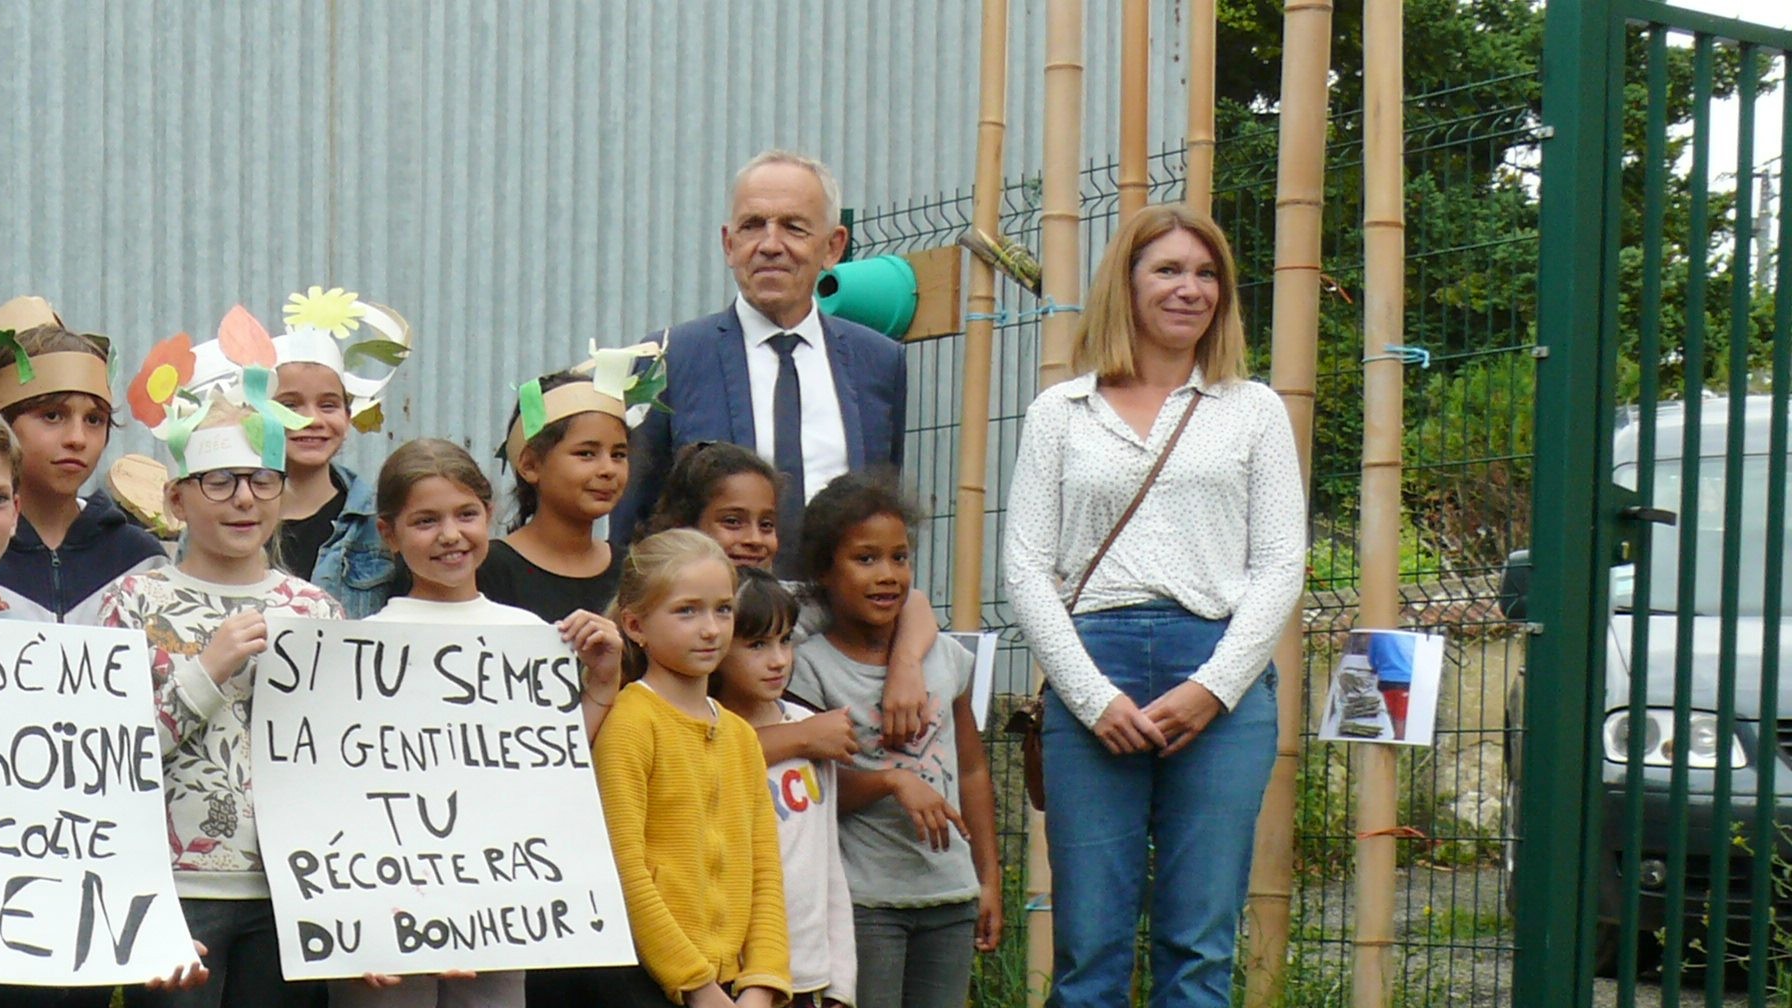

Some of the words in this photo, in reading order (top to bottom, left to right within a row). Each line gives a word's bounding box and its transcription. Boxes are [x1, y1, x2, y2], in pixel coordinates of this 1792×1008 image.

[342, 638, 409, 701] TU
[433, 636, 581, 713] SÈMES
[267, 716, 318, 764] LA
[366, 790, 458, 846] TU
[297, 919, 361, 963] DU
